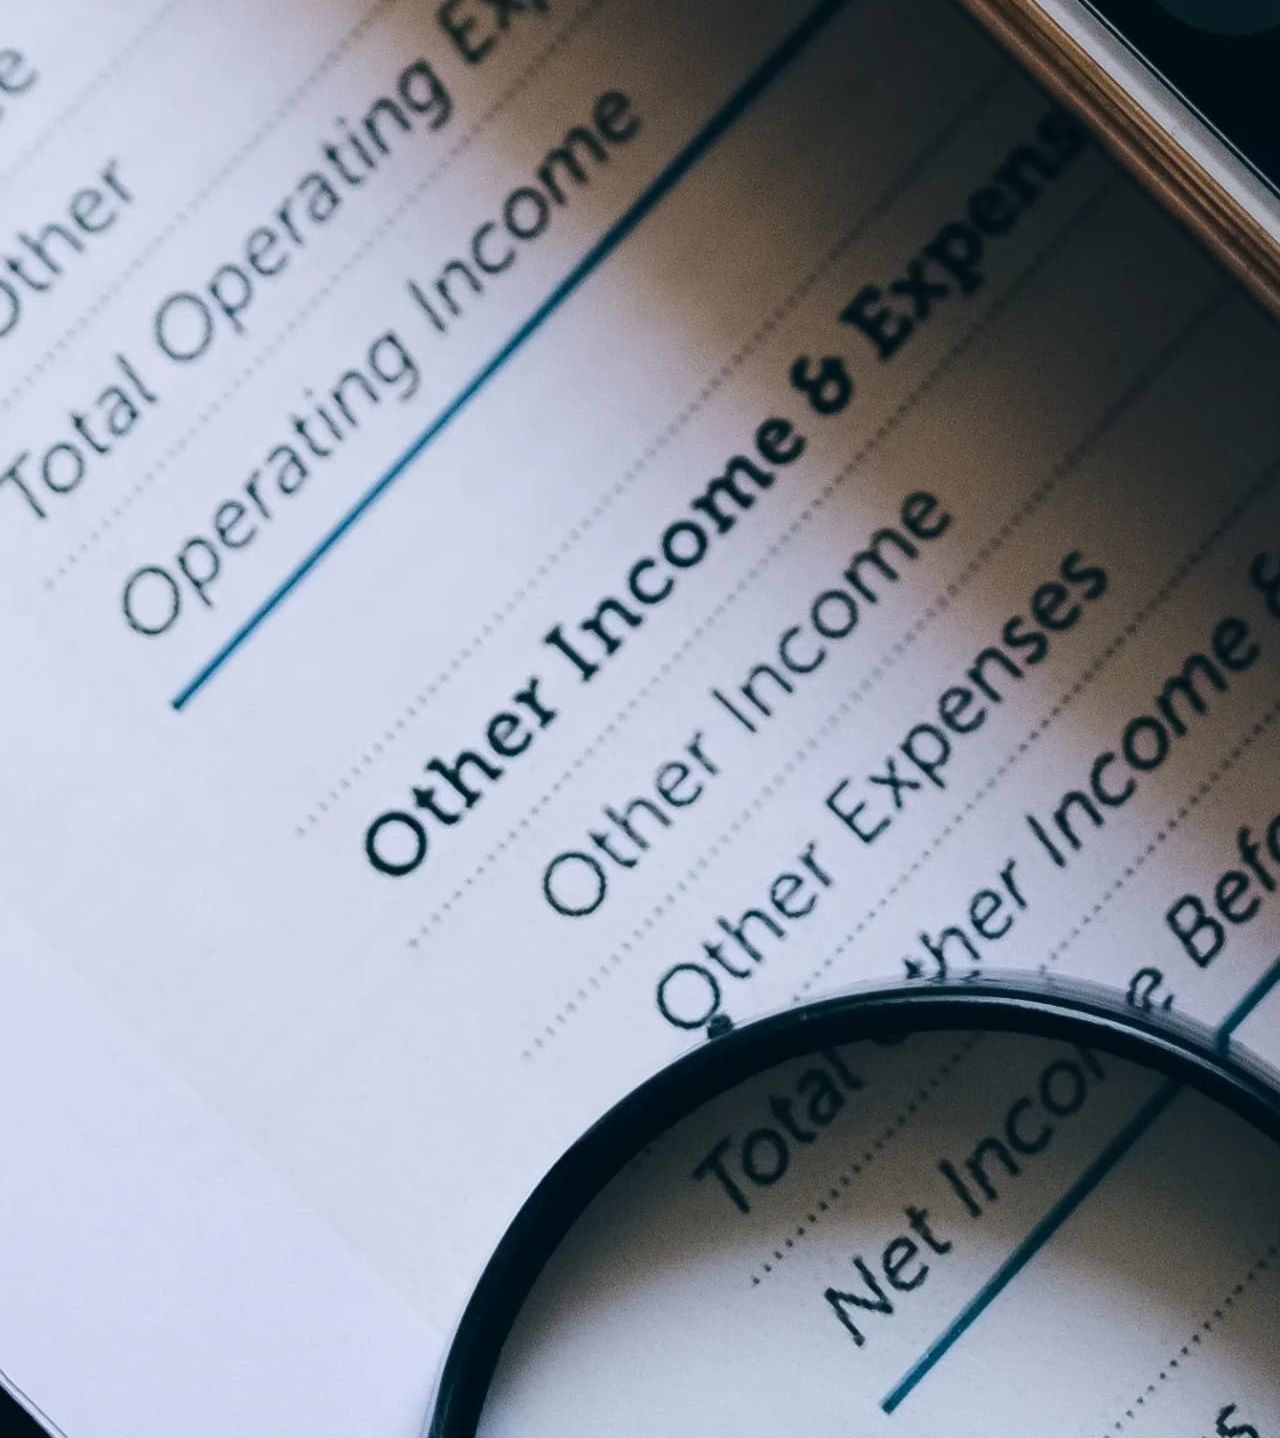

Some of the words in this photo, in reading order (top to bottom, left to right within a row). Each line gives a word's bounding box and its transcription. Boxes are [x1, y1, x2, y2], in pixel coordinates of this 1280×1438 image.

[118, 322, 426, 644] Operating
[415, 80, 641, 336] Income
[150, 58, 454, 370] Operating
[361, 678, 559, 884] Other
[543, 413, 808, 684] Income
[789, 354, 854, 415] &
[837, 105, 1095, 363] Expens
[539, 719, 721, 925] Other
[713, 479, 954, 736] Income
[654, 841, 836, 1030] Other
[824, 537, 1111, 843] Expenses
[691, 1042, 864, 1216] Total
[903, 858, 1030, 982] ther
[1025, 616, 1261, 869] Income
[823, 1203, 953, 1347] Net
